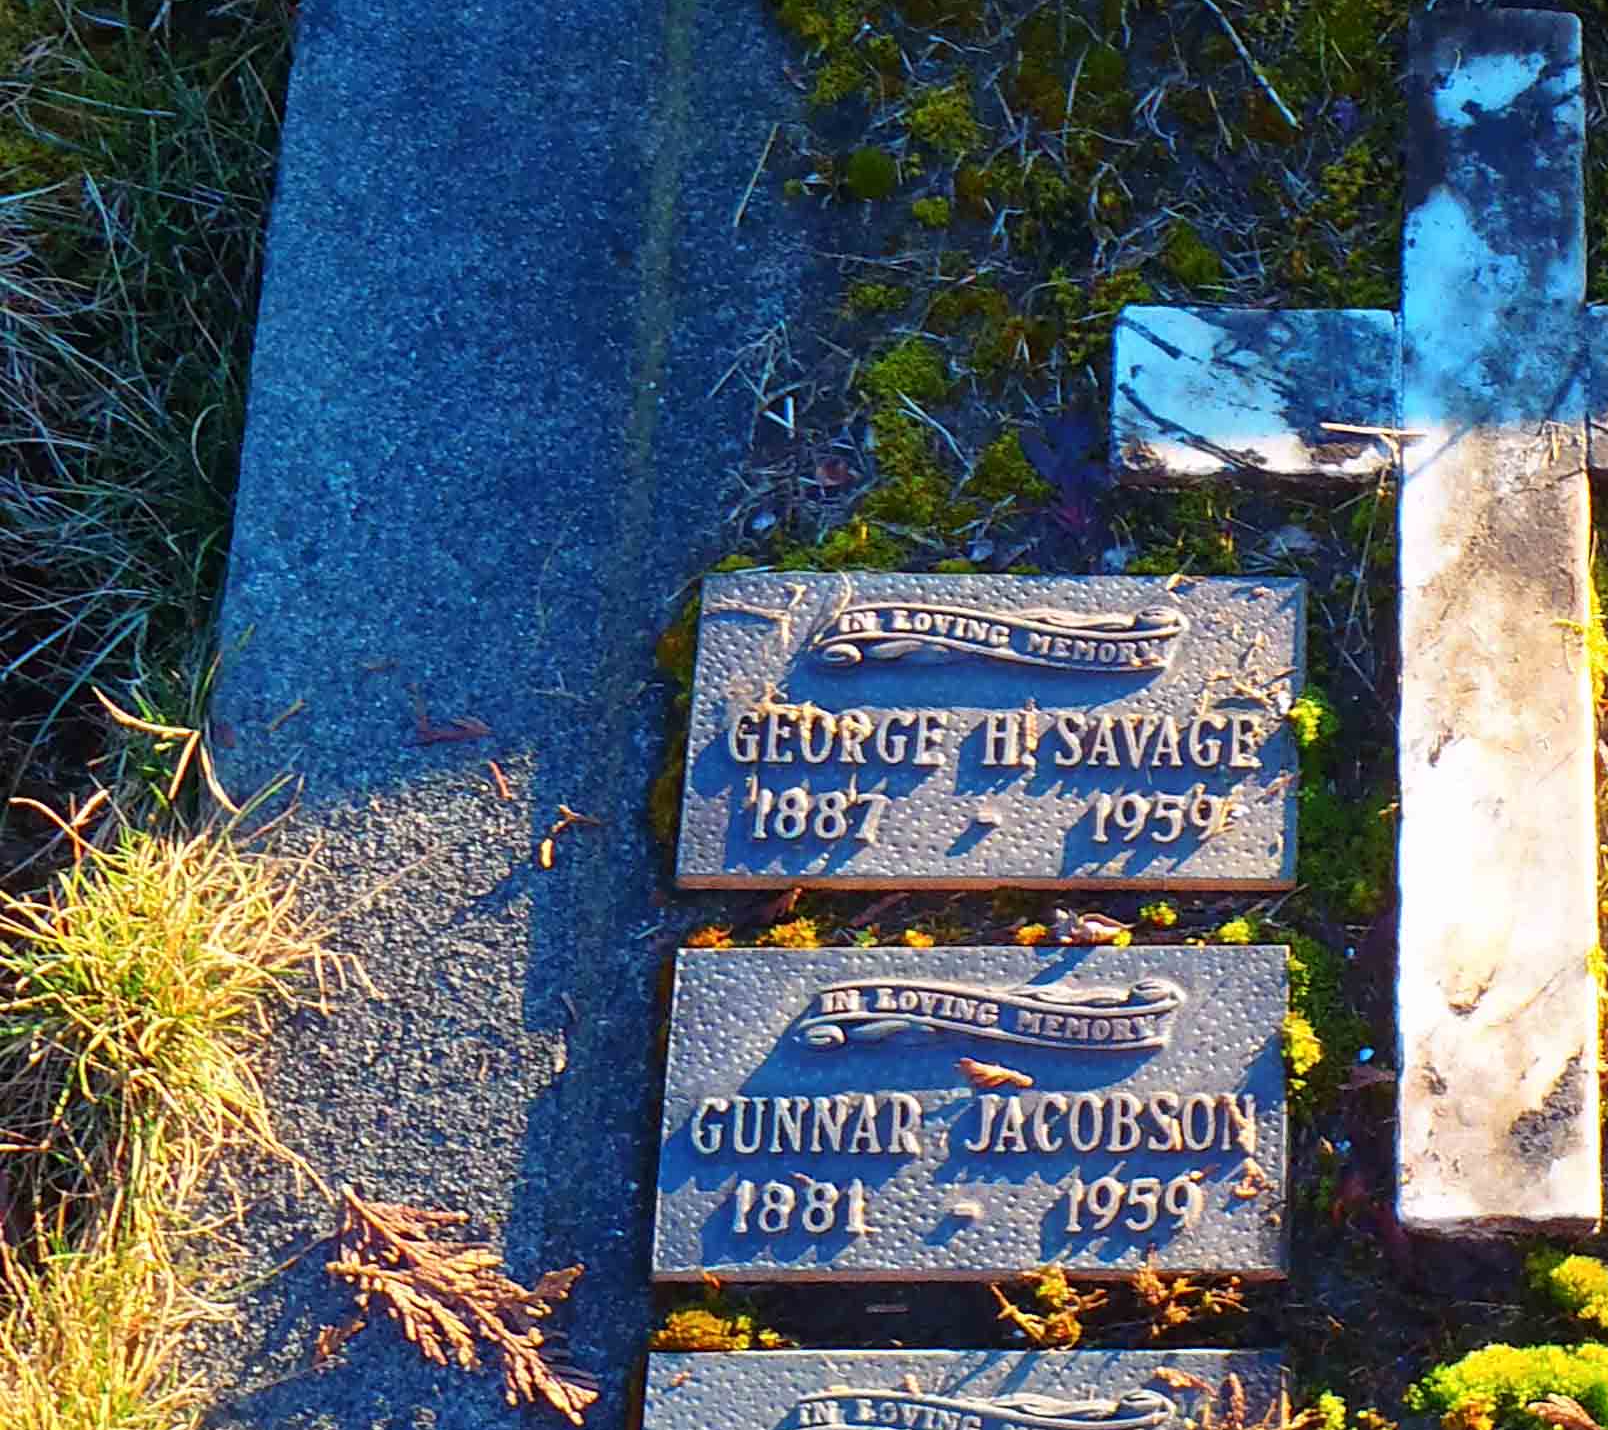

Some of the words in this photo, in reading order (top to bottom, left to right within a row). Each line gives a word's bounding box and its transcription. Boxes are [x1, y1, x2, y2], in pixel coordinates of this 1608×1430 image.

[838, 611, 878, 634] IN
[895, 609, 1009, 644] LOVING
[1027, 632, 1155, 665] MEMORY
[729, 713, 951, 765] GEORGE
[1056, 713, 1263, 768] SAVAGE
[752, 789, 887, 840] 1887
[1093, 794, 1220, 842] 1959
[822, 989, 861, 1014] IN
[876, 989, 998, 1026] LOVING
[1017, 1010, 1153, 1039] MEMORY
[692, 1095, 922, 1155] GUNNAR
[965, 1095, 1257, 1153] JACOBSON
[733, 1181, 865, 1234] 1881
[1065, 1179, 1202, 1233] 1959
[799, 1401, 840, 1425] IN
